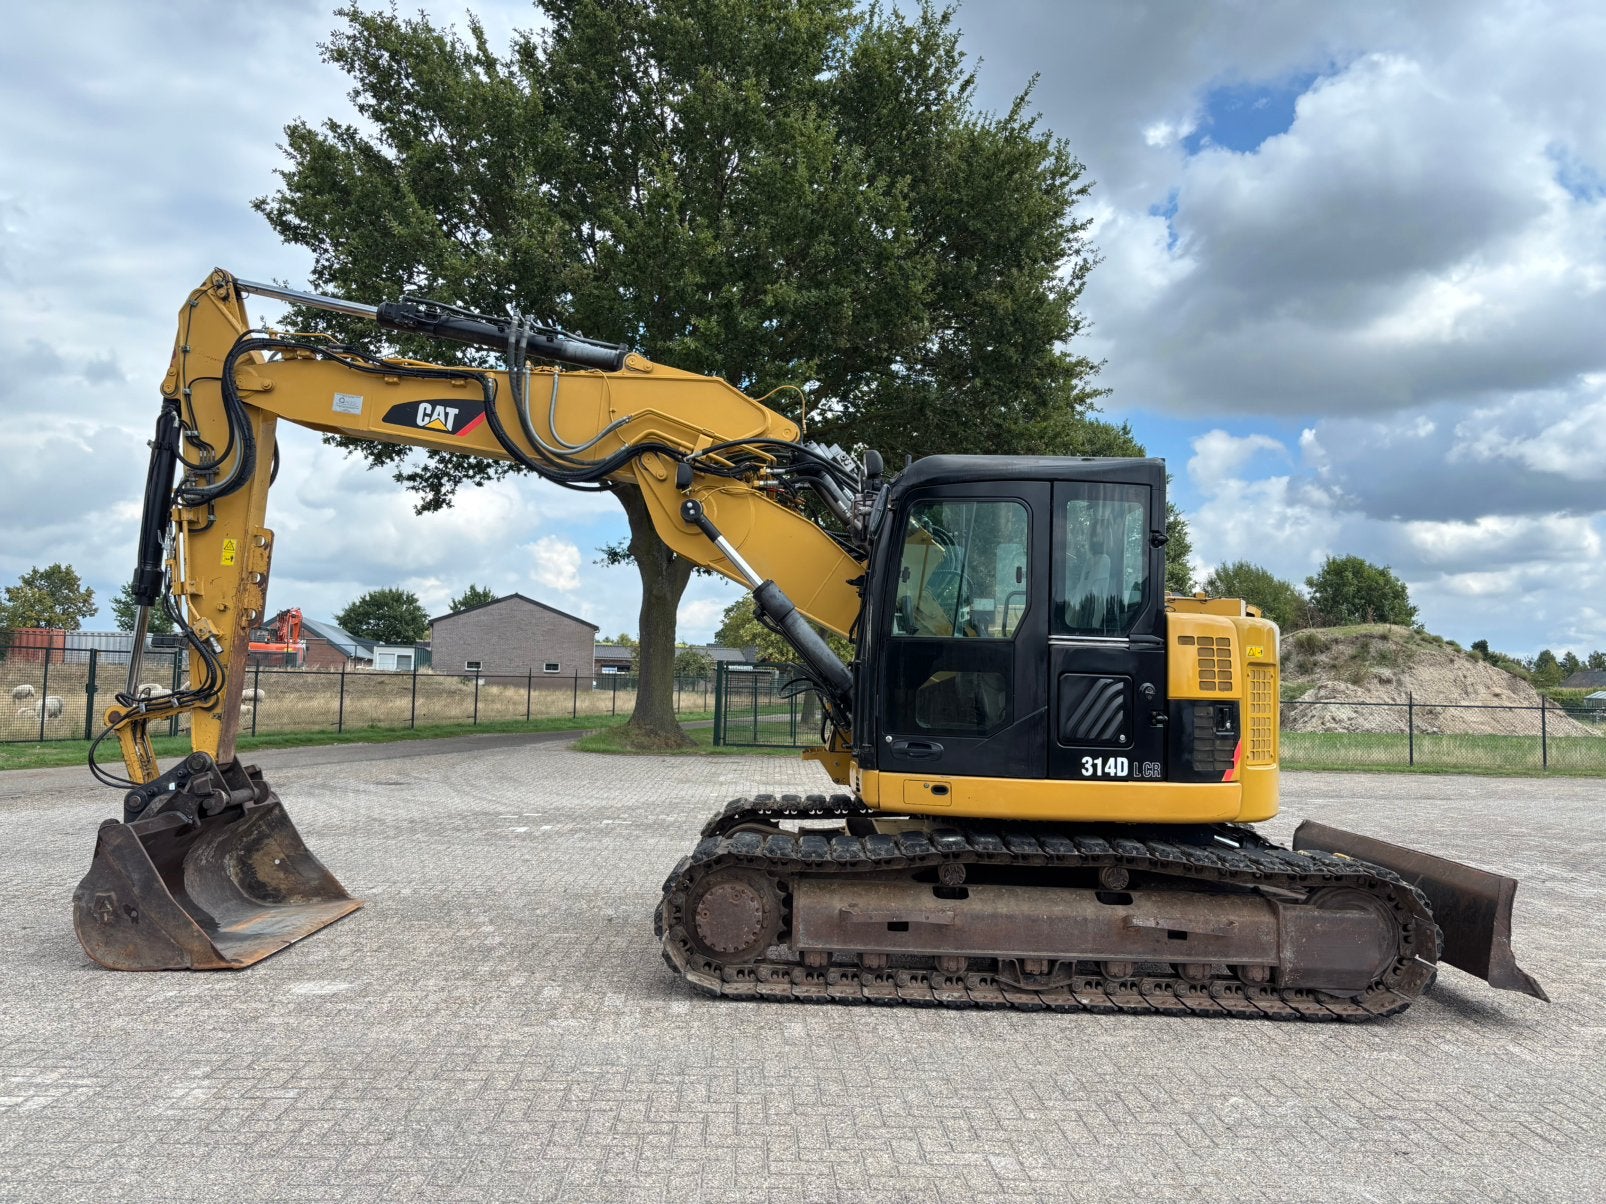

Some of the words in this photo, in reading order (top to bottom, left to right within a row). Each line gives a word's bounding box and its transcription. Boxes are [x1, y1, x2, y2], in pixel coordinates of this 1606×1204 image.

[417, 403, 459, 431] CAT
[1081, 756, 1129, 777] 314D
[1133, 761, 1161, 778] LCR
